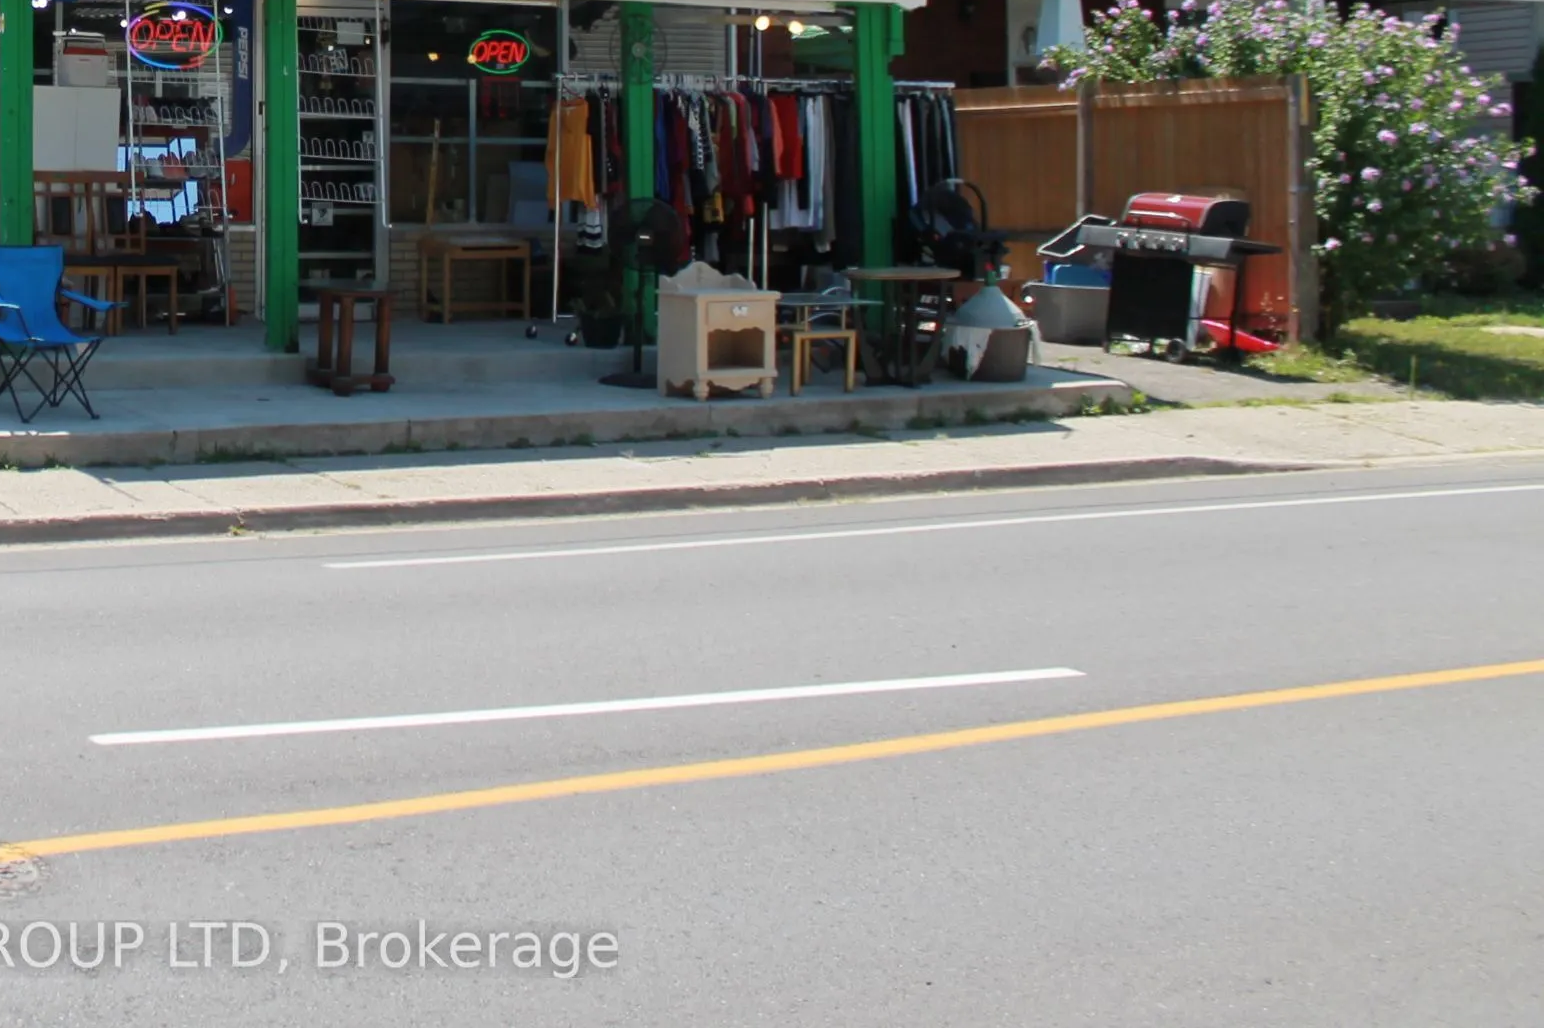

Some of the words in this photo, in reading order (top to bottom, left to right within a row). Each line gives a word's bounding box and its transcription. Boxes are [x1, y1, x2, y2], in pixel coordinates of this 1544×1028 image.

[131, 18, 215, 52] OPEN
[237, 26, 249, 80] PEPSI
[473, 41, 525, 64] OPEN
